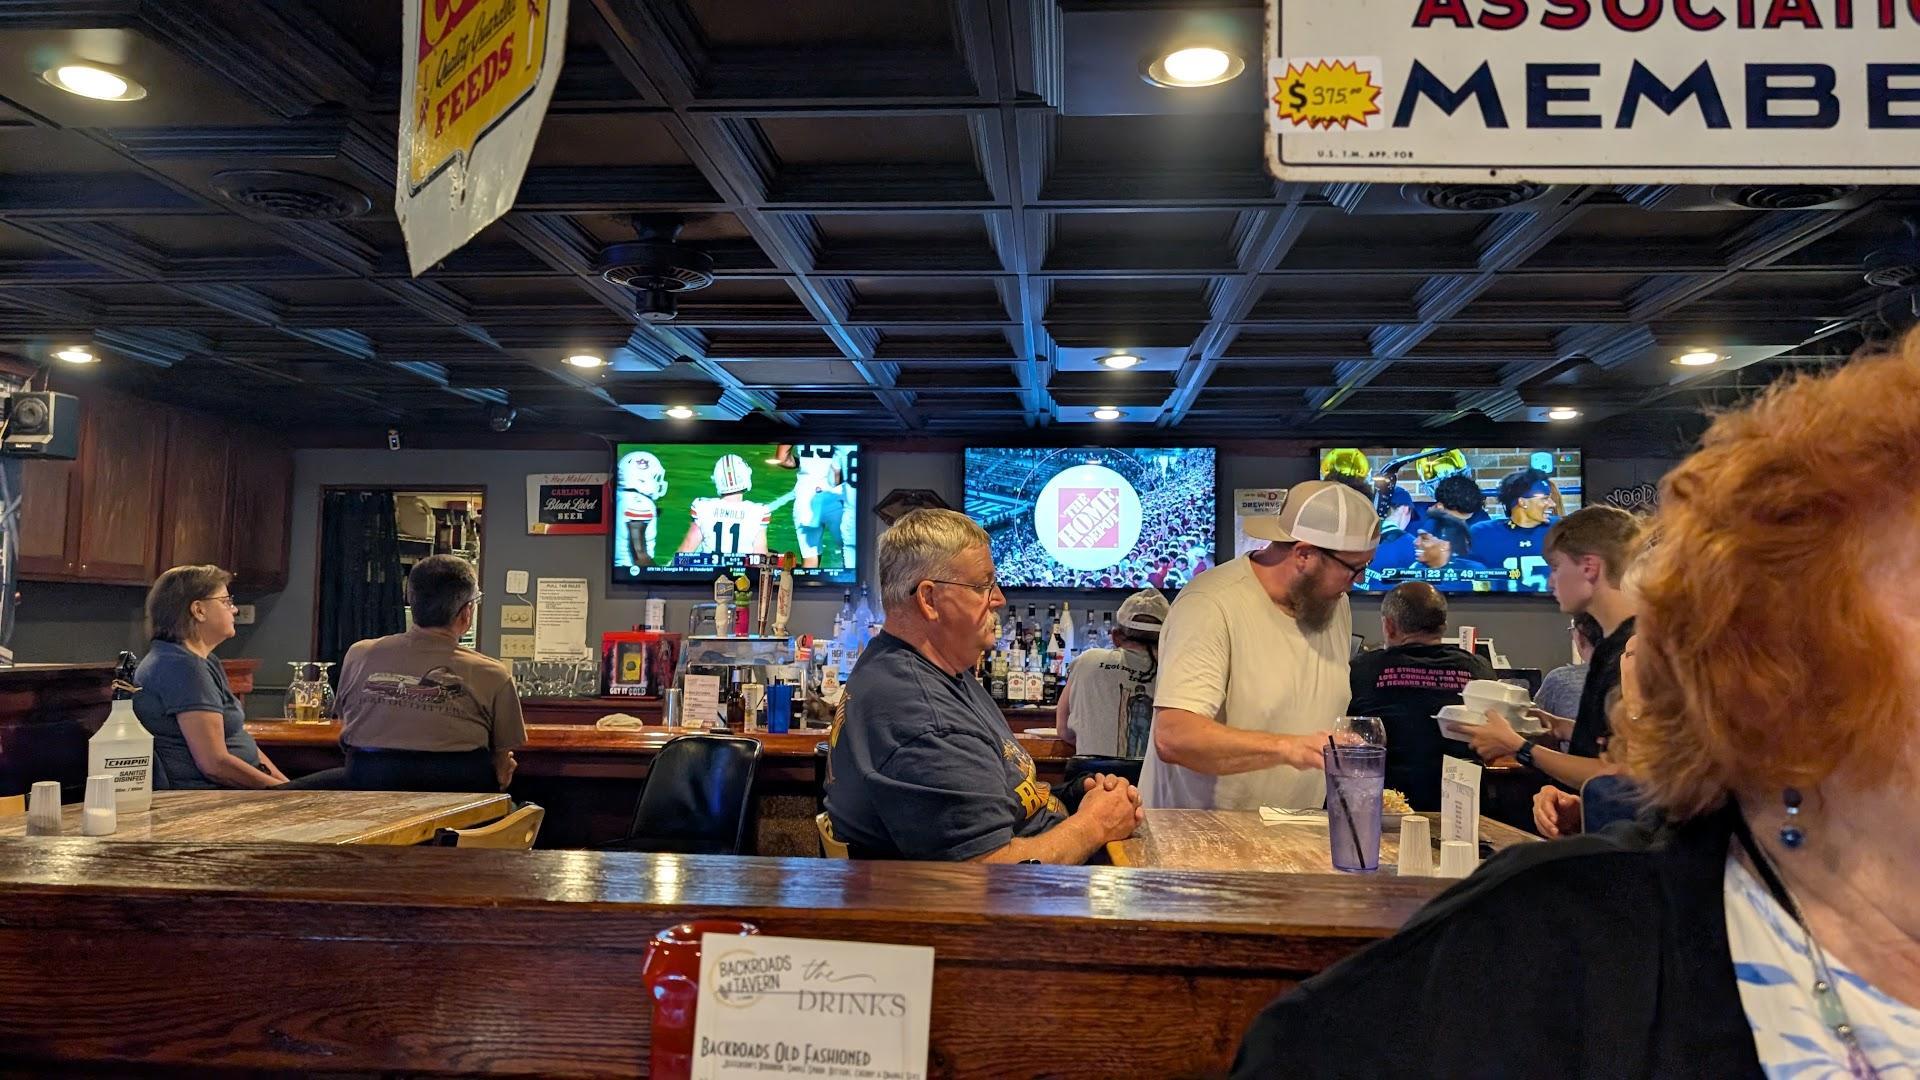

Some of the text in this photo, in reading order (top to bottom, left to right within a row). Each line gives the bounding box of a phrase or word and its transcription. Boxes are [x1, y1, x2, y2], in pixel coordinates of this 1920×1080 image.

[1411, 0, 1920, 32] ASSOCIATI
[435, 32, 515, 139] FEEDS
[1392, 58, 1920, 129] MEMBE
[1394, 150, 1413, 158] FOR
[544, 498, 598, 512] Black Label
[557, 512, 584, 520] BEER
[1063, 493, 1091, 519] THE
[1058, 488, 1120, 548] HOME
[1080, 510, 1120, 548] DEPOT
[713, 521, 741, 553] 11
[1427, 569, 1441, 578] 23
[1460, 569, 1474, 578] 49
[609, 687, 621, 695] GET
[628, 687, 646, 697] COLD
[108, 758, 148, 767] CHAPIN
[718, 955, 793, 977] BACKROADS
[732, 974, 781, 994] TAVERN
[797, 989, 907, 1018] DRINKS
